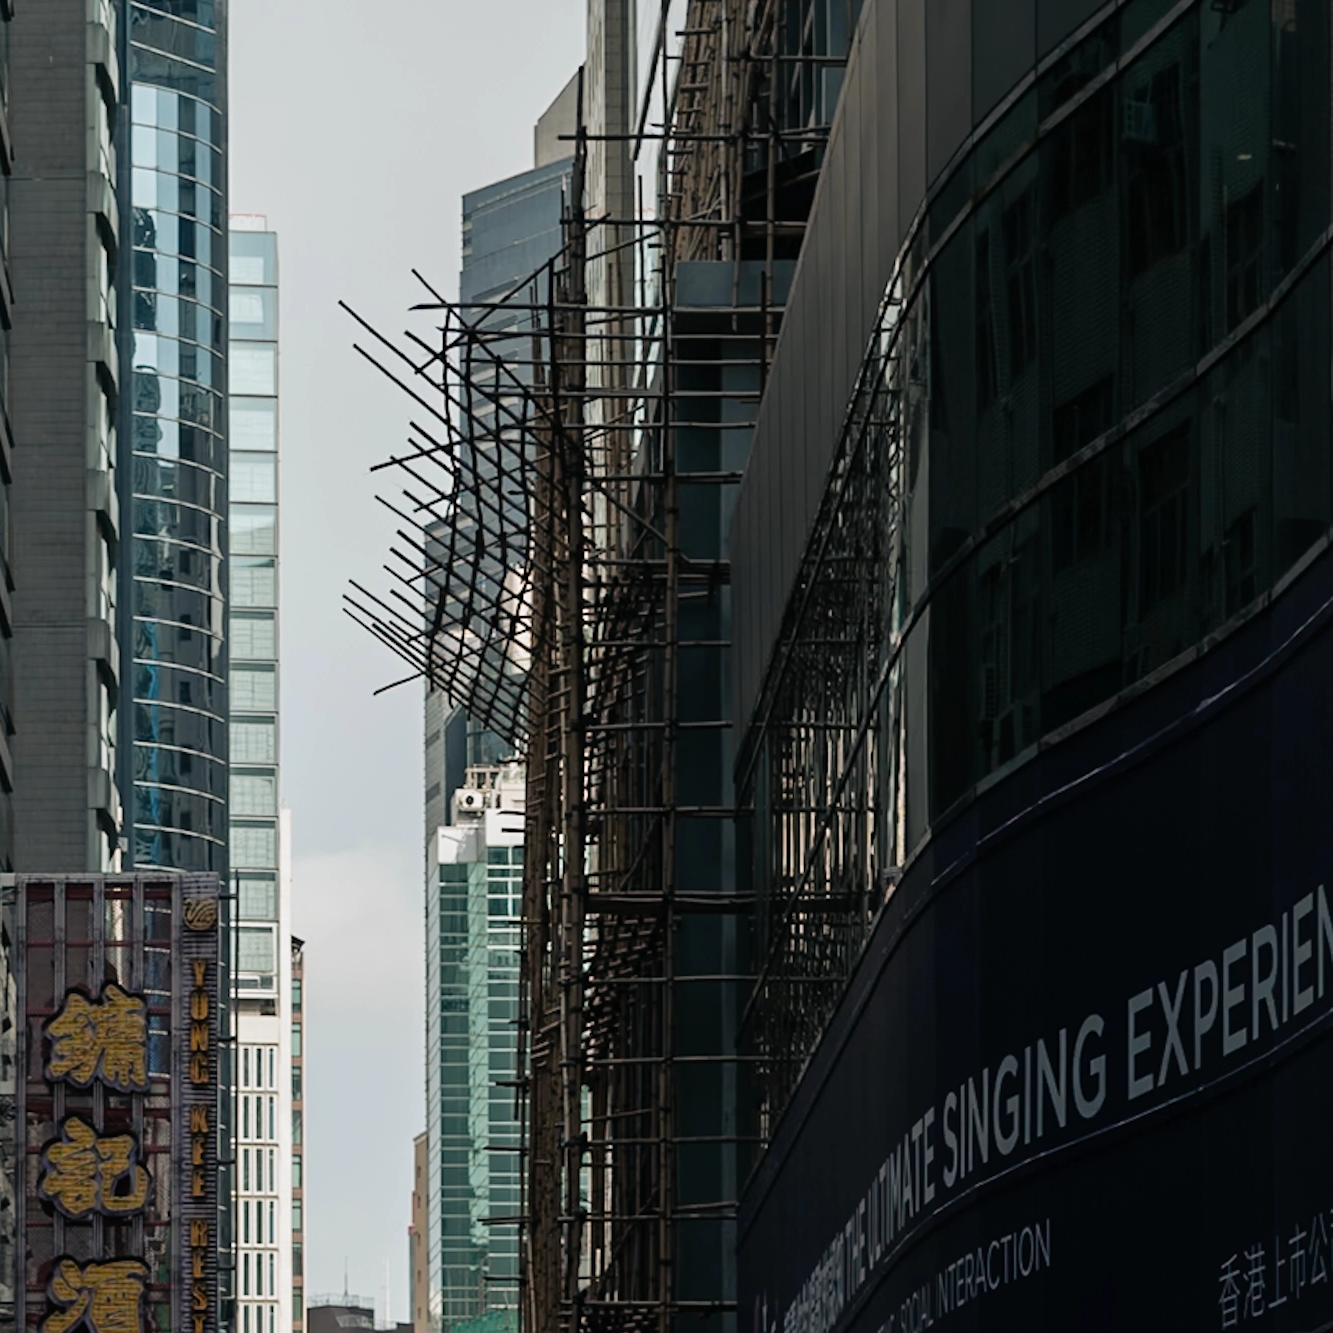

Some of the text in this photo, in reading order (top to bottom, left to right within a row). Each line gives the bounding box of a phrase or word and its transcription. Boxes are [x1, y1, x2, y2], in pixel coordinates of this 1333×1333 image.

[189, 957, 211, 1087] YUNG
[189, 1103, 211, 1200] KEE
[867, 1106, 936, 1270] ULTIMATE
[942, 1013, 1106, 1188] SINGING
[935, 1219, 1052, 1319] INTERACTION
[1218, 1208, 1333, 1331] 香港上市公
